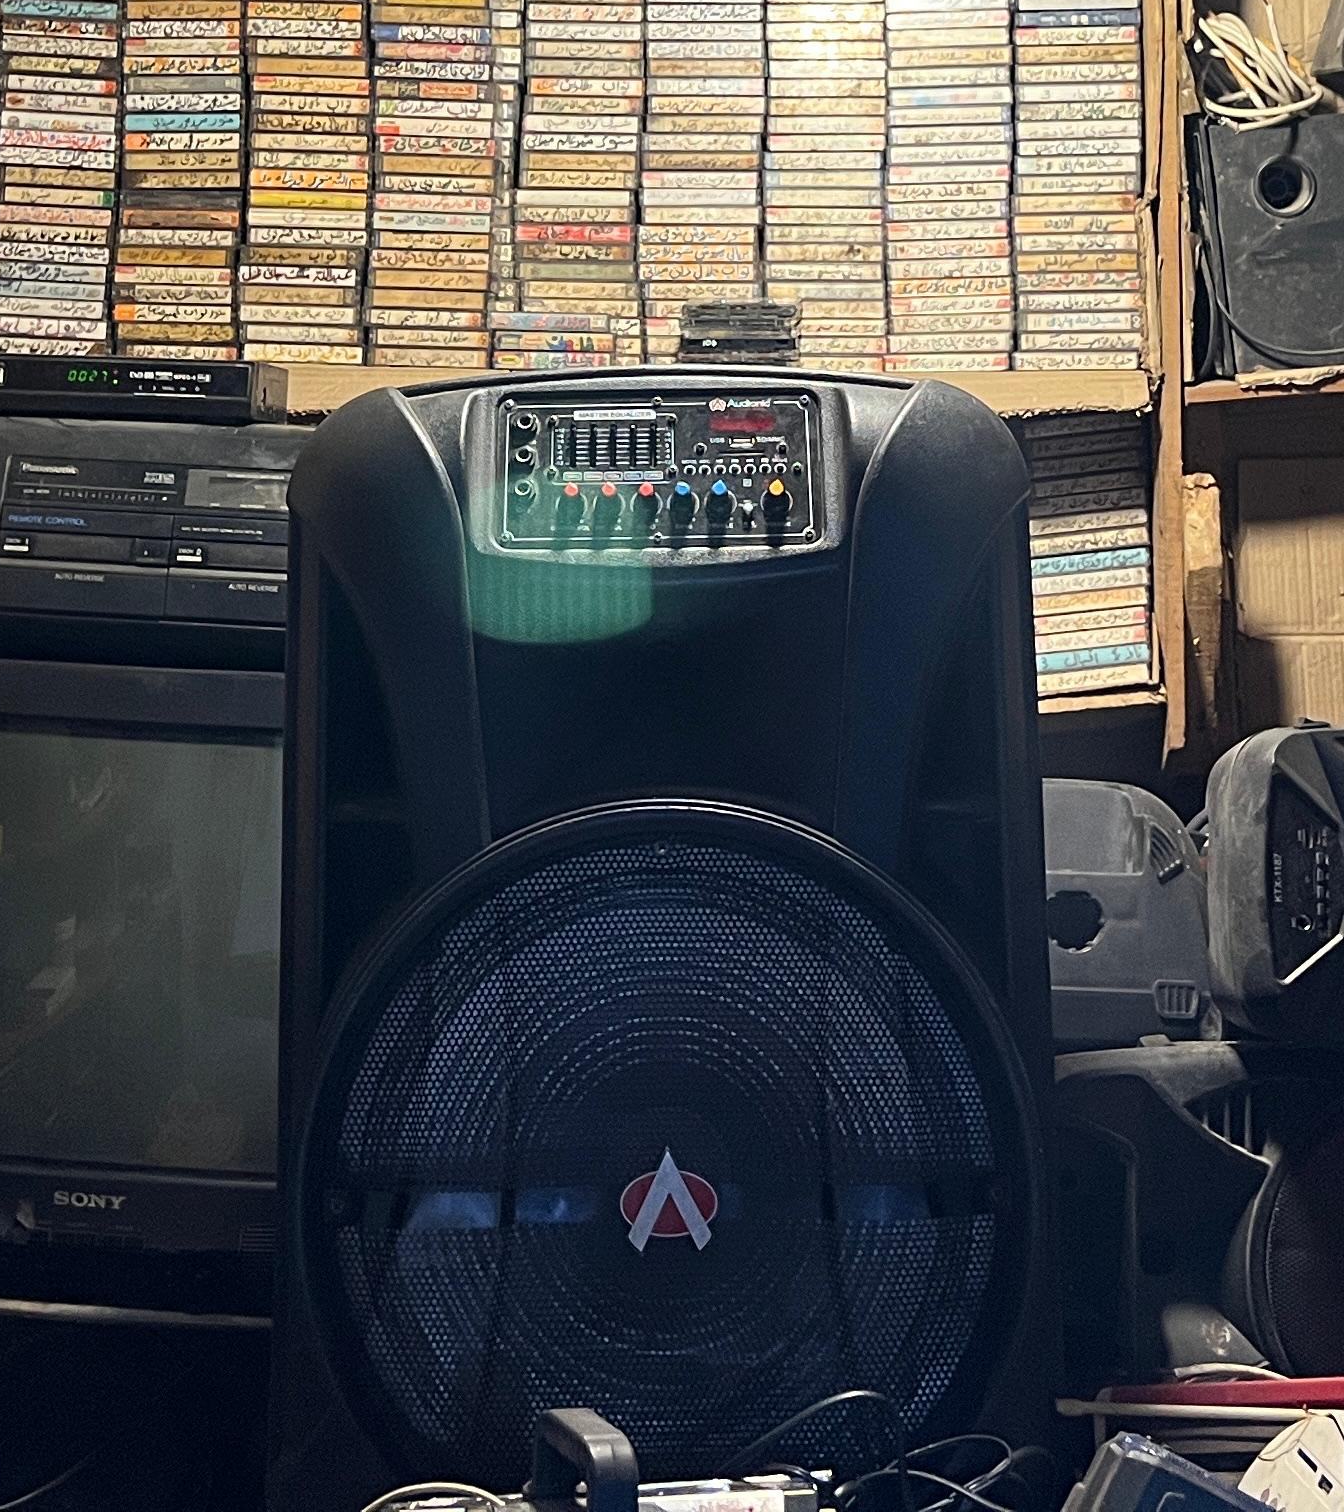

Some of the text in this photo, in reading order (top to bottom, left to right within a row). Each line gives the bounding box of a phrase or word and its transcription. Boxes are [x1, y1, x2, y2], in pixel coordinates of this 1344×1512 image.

[8, 514, 88, 527] REMOTE CONTROL
[54, 572, 105, 583] AUTO REVERSE
[228, 582, 279, 593] AUTO REVERSE
[54, 1190, 127, 1210] SONY
